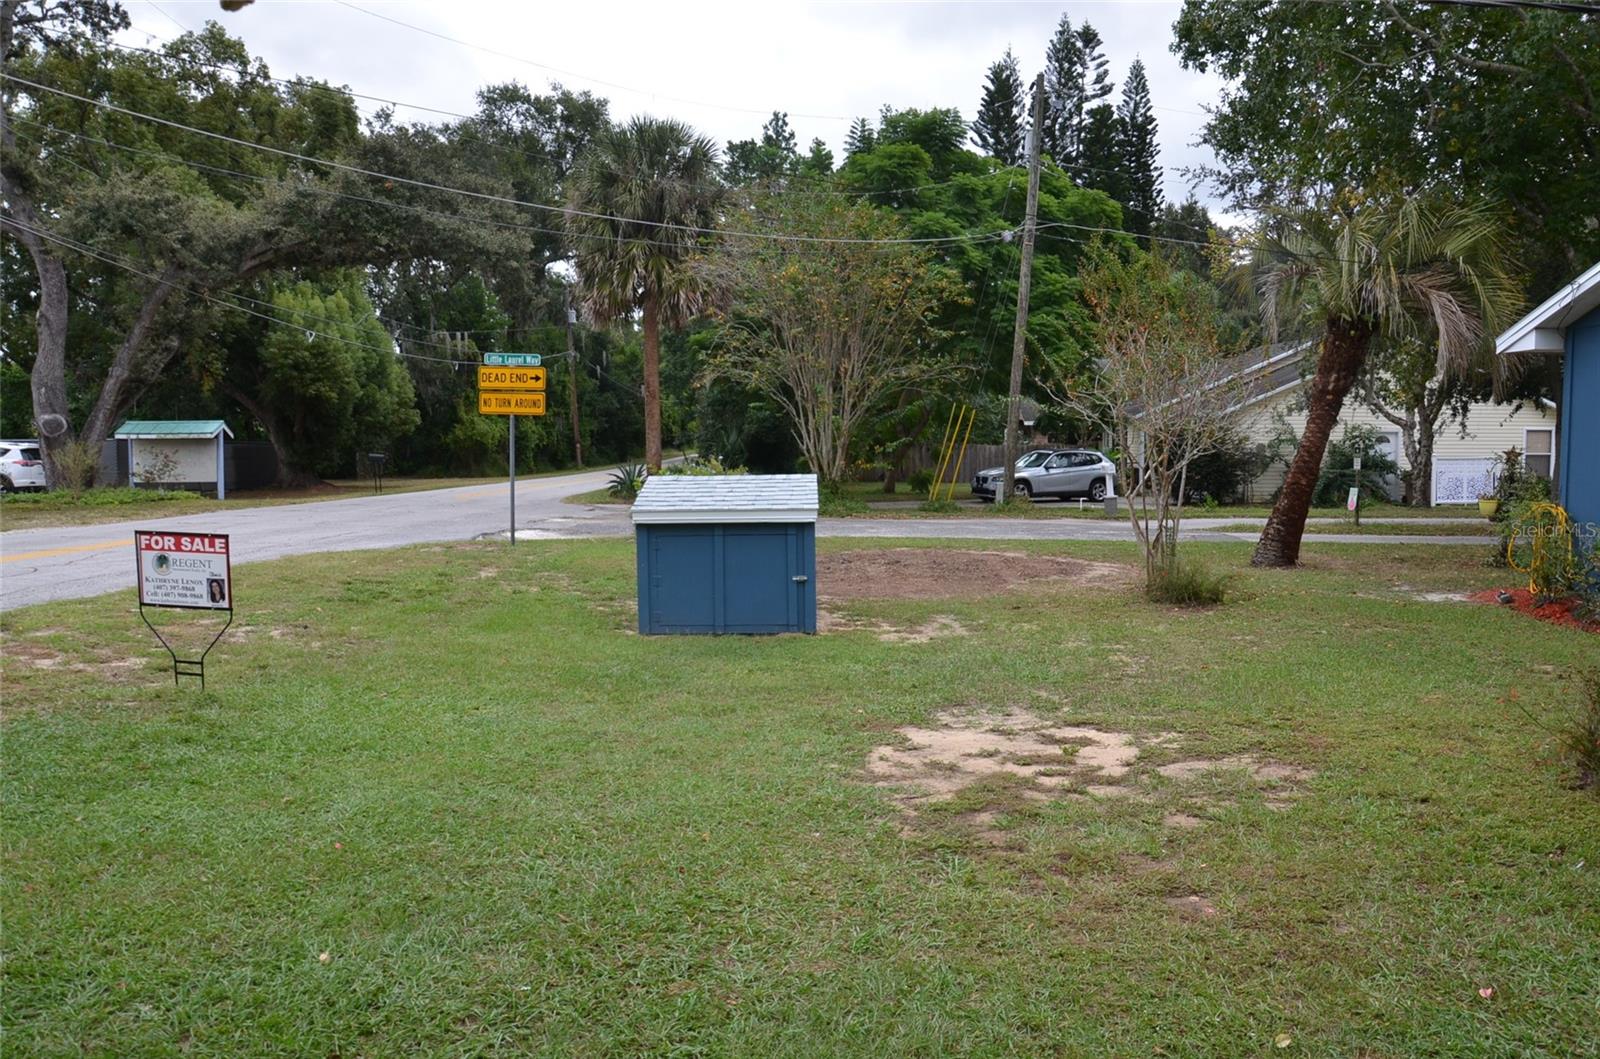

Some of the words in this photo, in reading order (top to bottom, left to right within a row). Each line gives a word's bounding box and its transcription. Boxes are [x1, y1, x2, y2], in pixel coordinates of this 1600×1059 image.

[486, 354, 502, 363] Little
[505, 355, 523, 364] Laurel
[526, 355, 538, 365] Way
[481, 372, 507, 383] DEAD
[510, 373, 528, 383] END
[483, 397, 492, 407] NO
[495, 397, 512, 408] TURN
[515, 398, 541, 408] AROUND
[140, 535, 175, 550] FOR
[180, 537, 226, 553] SALE
[172, 558, 213, 569] REGENT
